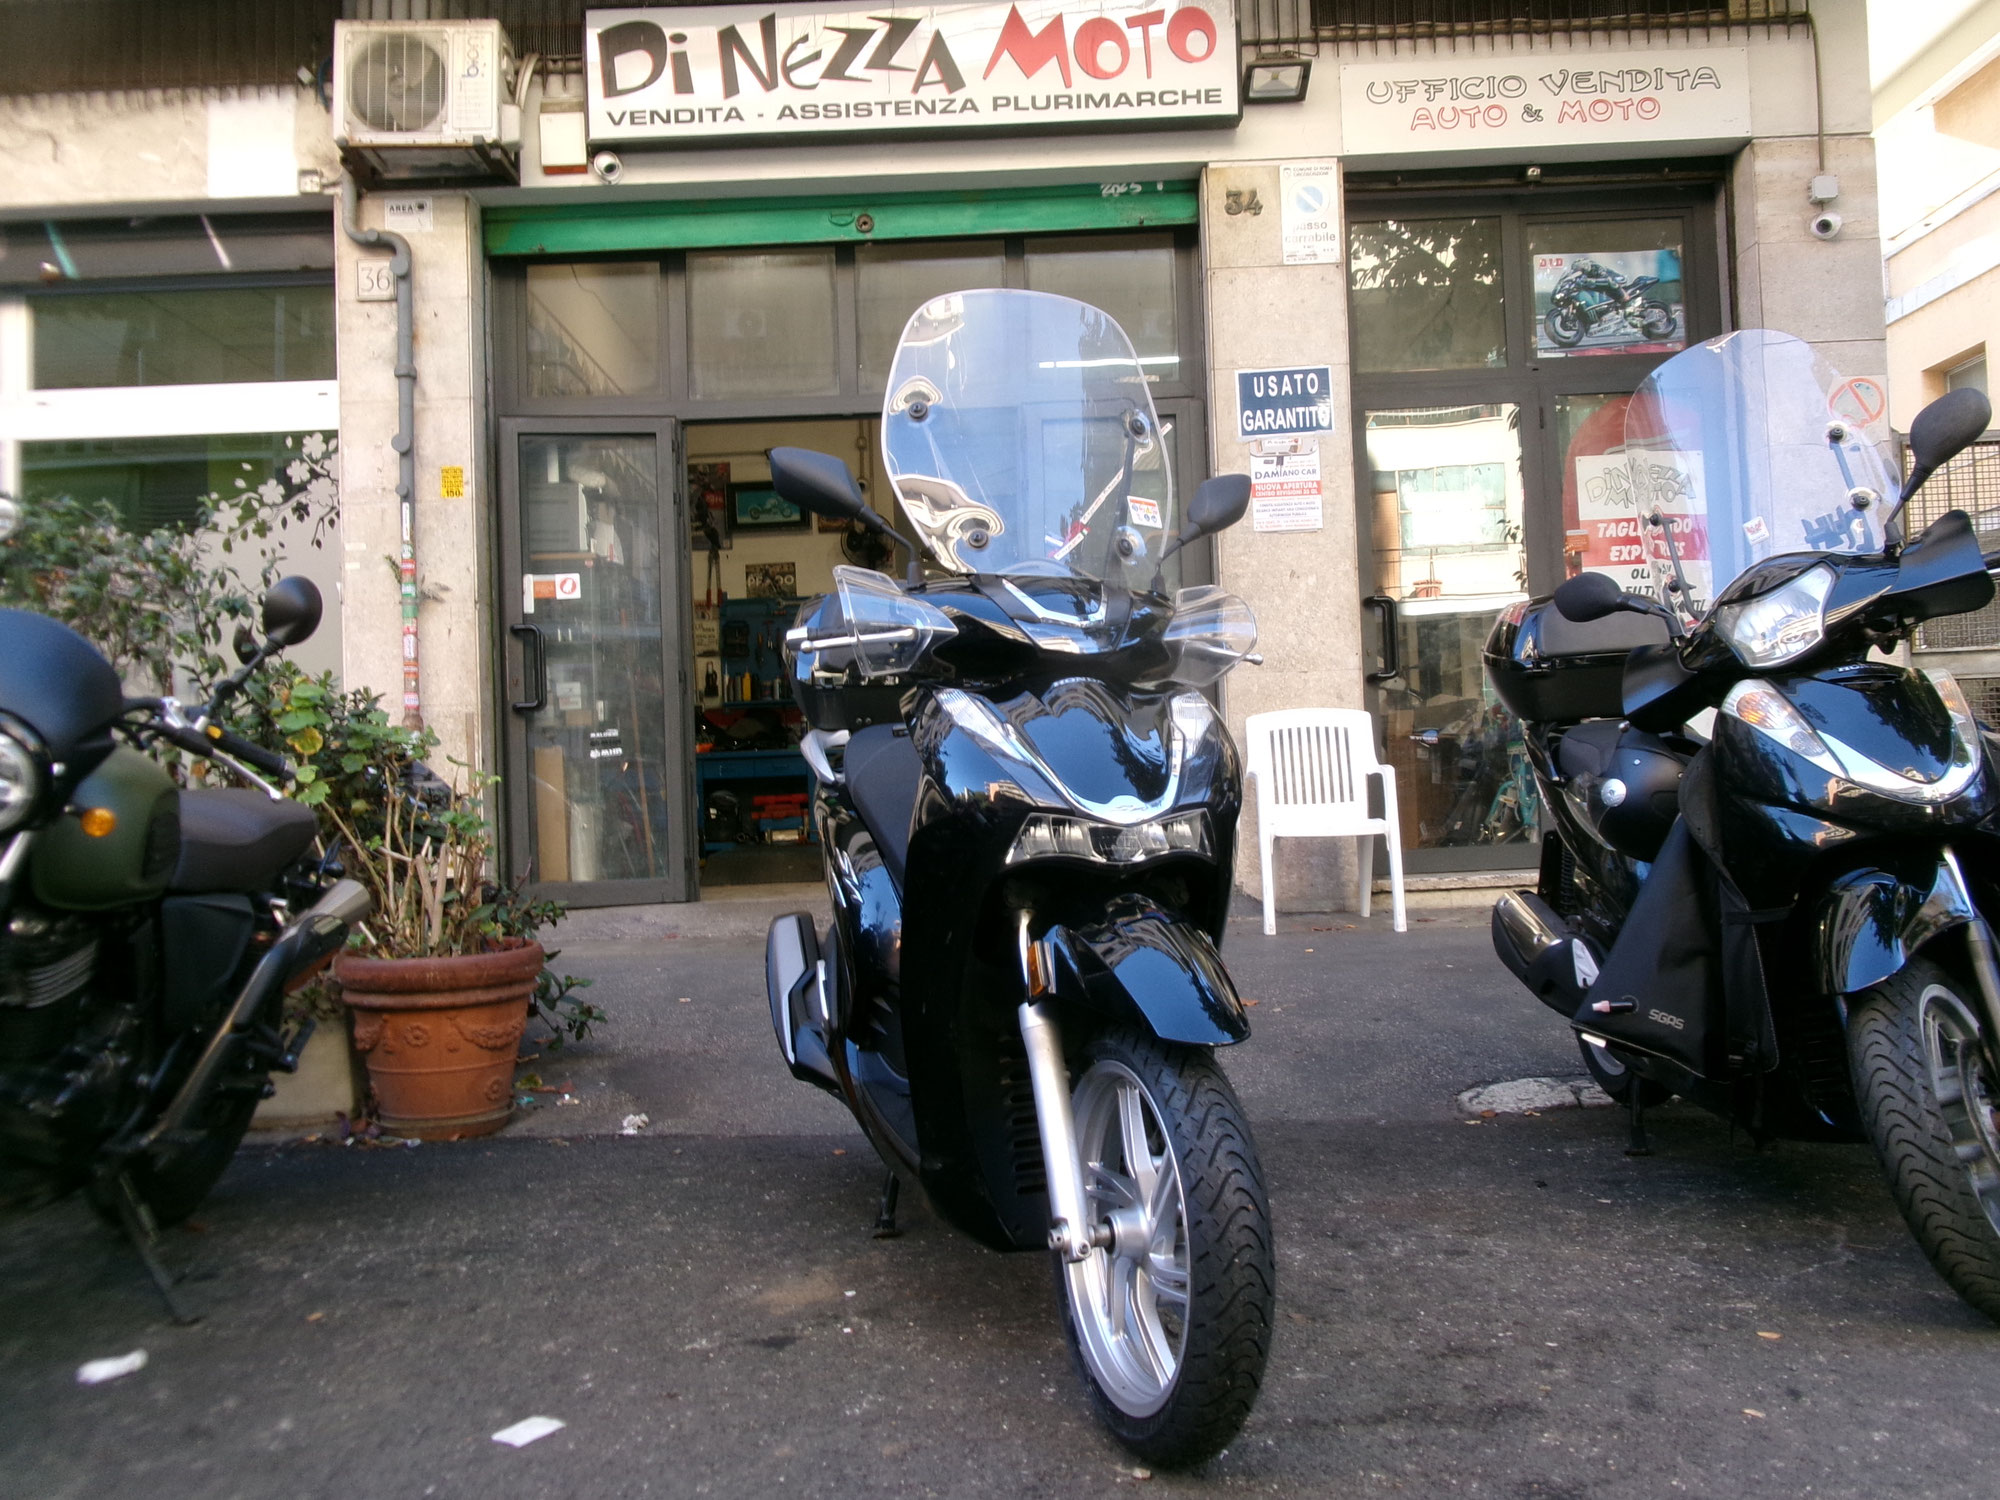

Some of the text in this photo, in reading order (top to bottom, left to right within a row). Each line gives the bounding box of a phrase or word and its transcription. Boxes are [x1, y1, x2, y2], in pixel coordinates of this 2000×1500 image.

[982, 4, 1218, 89] MOTO
[1366, 66, 1722, 104] UFFICIO VENDITA
[606, 107, 745, 127] VENDITA
[776, 96, 980, 122] ASSISTENZA
[991, 87, 1223, 113] PLURIMARCHE
[1411, 97, 1661, 131] AUTO & MOTO
[1224, 189, 1263, 216] 34
[361, 266, 391, 293] 36
[1253, 372, 1319, 398] USATO
[1242, 405, 1331, 432] GARANTITO
[1254, 470, 1300, 480] DAMIANO
[1648, 1008, 1686, 1030] SGAS
